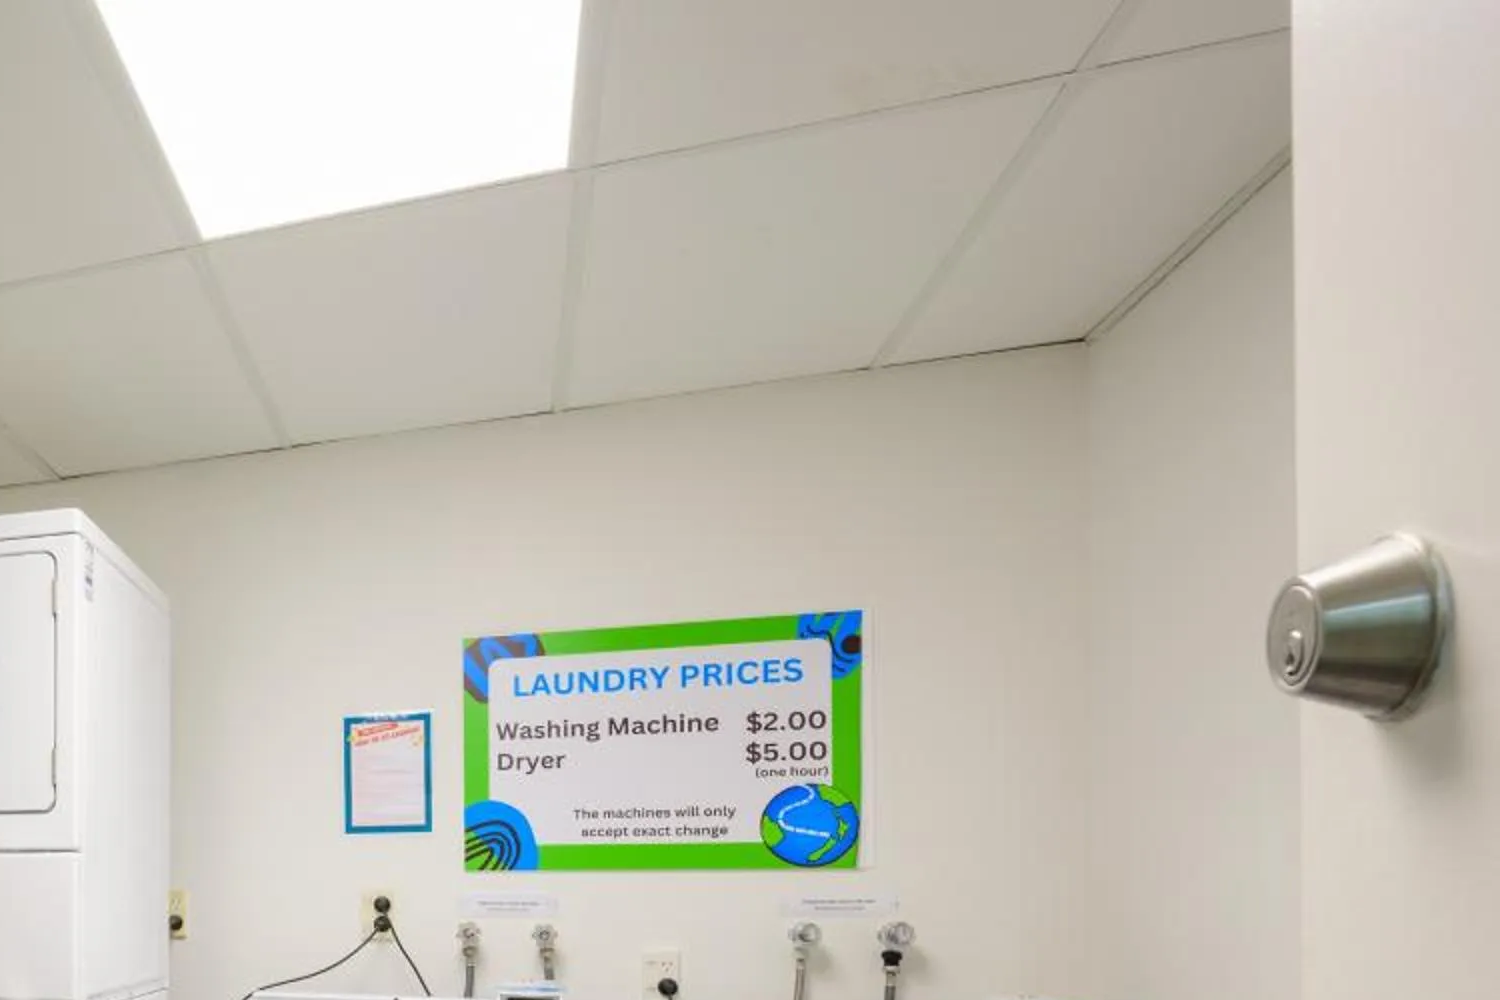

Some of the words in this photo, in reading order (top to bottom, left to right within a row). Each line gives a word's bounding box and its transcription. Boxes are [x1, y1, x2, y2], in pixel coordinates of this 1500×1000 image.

[513, 665, 670, 698] LAUNDRY
[679, 657, 804, 689] PRICES
[496, 719, 601, 742] Washing
[607, 713, 720, 736] Machine
[745, 709, 827, 735] $2.00
[497, 753, 566, 775] Dryer
[745, 741, 828, 765] $5.00
[755, 767, 787, 778] (one
[789, 766, 829, 778] hour)
[573, 809, 599, 820] The
[603, 807, 672, 819] machines
[674, 806, 700, 817] will
[703, 805, 737, 820] only
[581, 827, 629, 840] accept
[632, 826, 672, 838] exact
[675, 824, 729, 839] change
